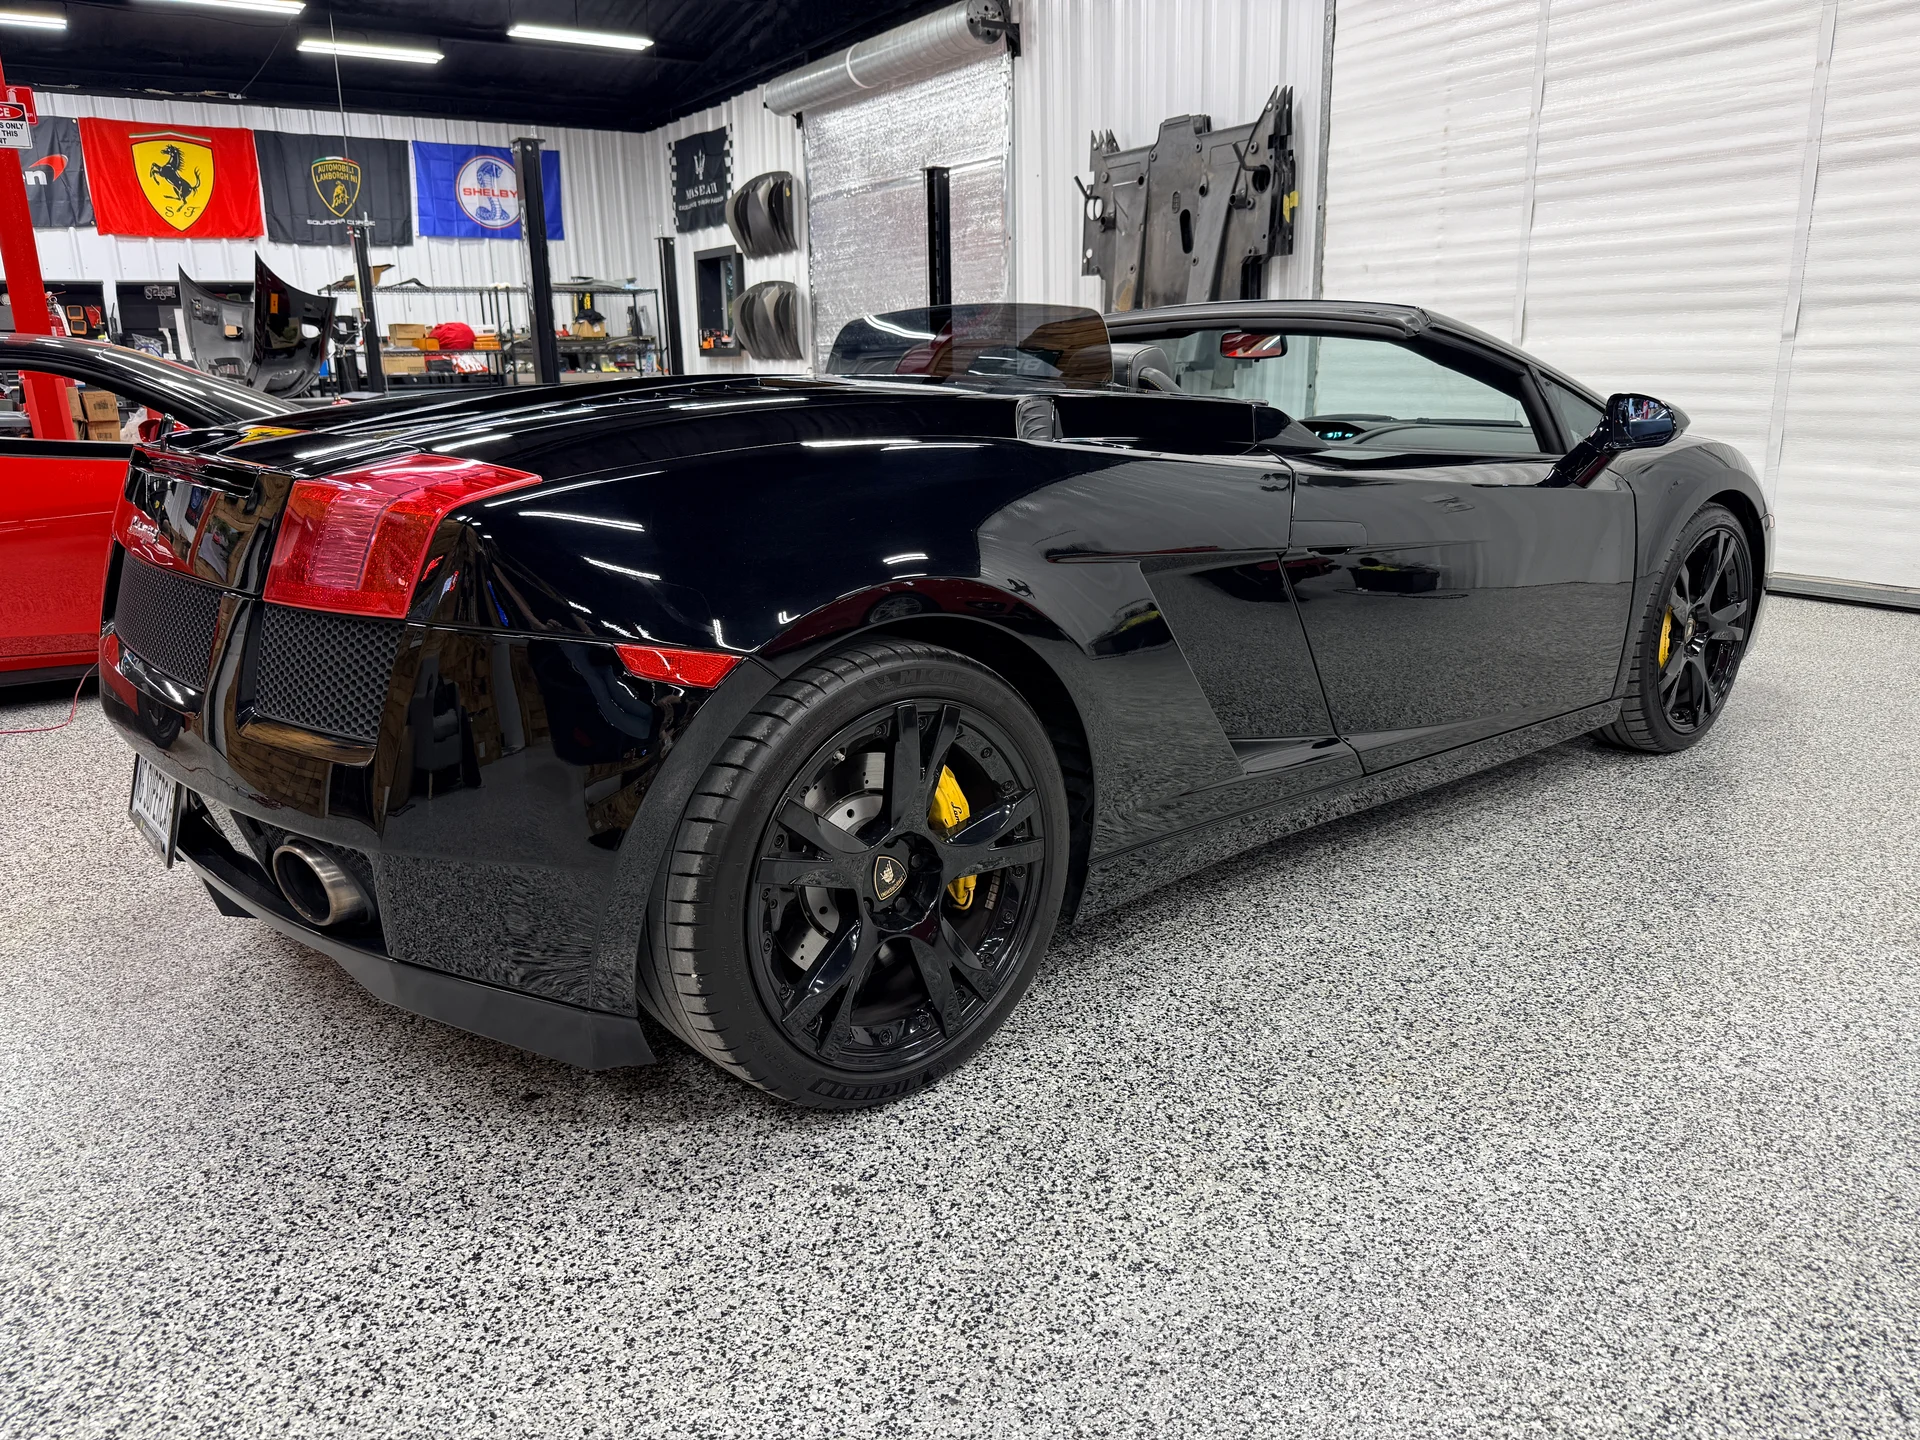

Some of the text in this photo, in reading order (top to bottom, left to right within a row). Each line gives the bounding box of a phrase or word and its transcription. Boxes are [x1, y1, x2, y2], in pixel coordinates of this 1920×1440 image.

[316, 172, 358, 183] LAMBORGHNI
[463, 187, 519, 199] SHELBY
[814, 1073, 926, 1100] MICHELIN
